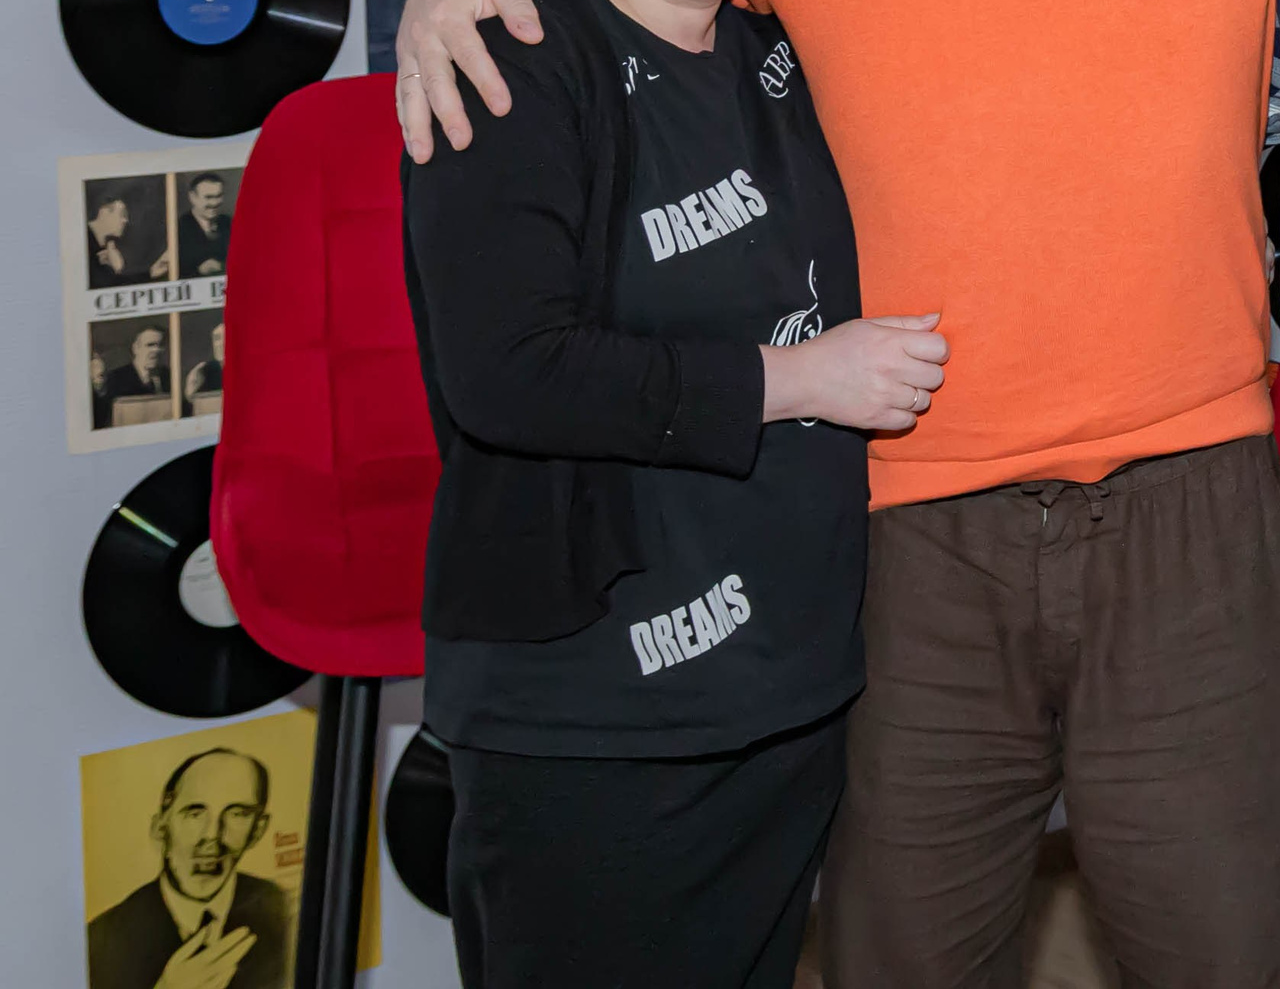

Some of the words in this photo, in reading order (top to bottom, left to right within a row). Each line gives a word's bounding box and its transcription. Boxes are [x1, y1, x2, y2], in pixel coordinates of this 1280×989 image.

[641, 168, 768, 262] DREAMS
[94, 282, 192, 310] СЕРГЕЙ
[629, 574, 751, 676] DREAMS
